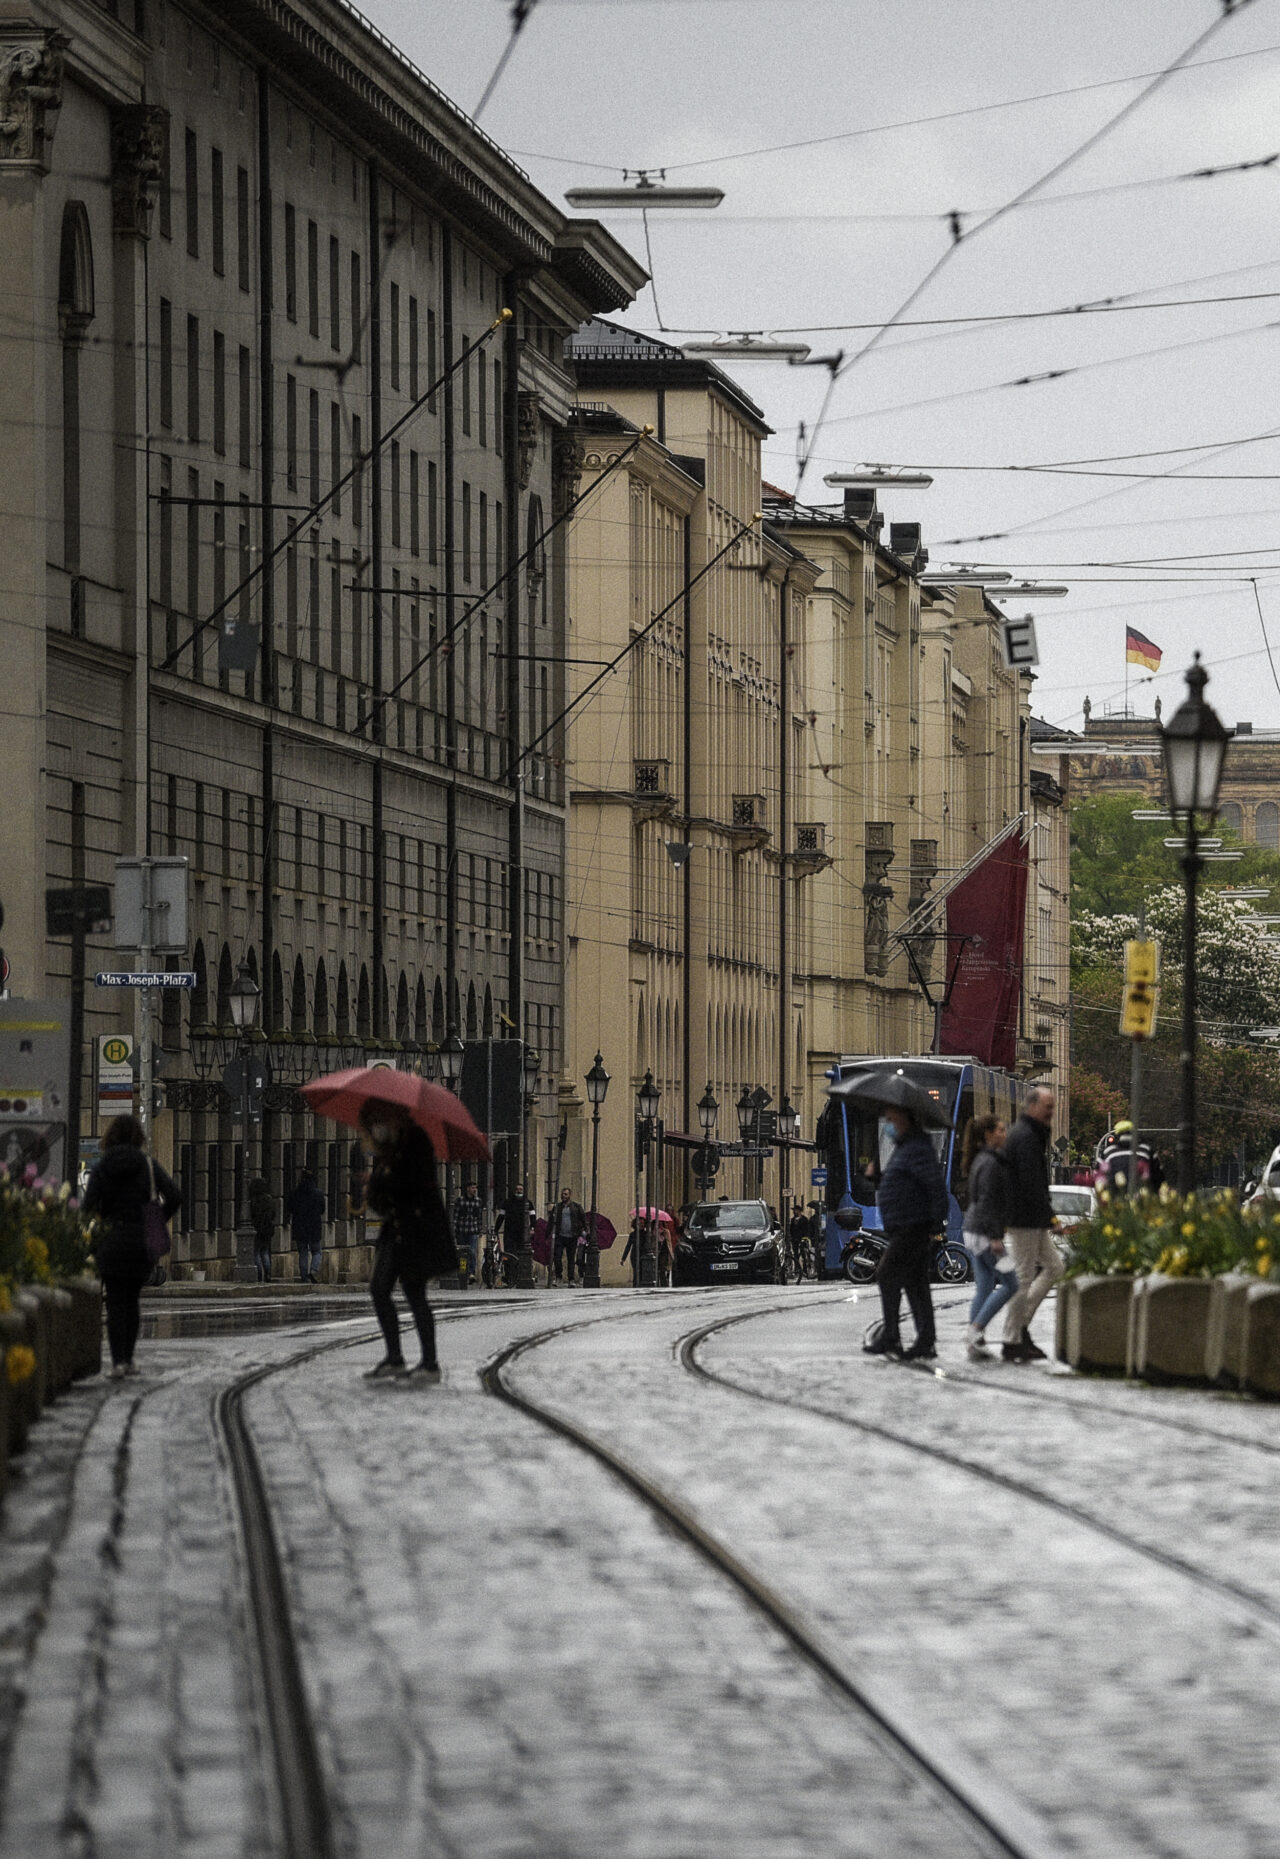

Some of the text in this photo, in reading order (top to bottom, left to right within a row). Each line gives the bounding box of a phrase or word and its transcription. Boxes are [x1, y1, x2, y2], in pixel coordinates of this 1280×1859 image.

[1006, 624, 1033, 664] E
[101, 974, 187, 986] Max-Joseph-Platz
[111, 1044, 122, 1059] H
